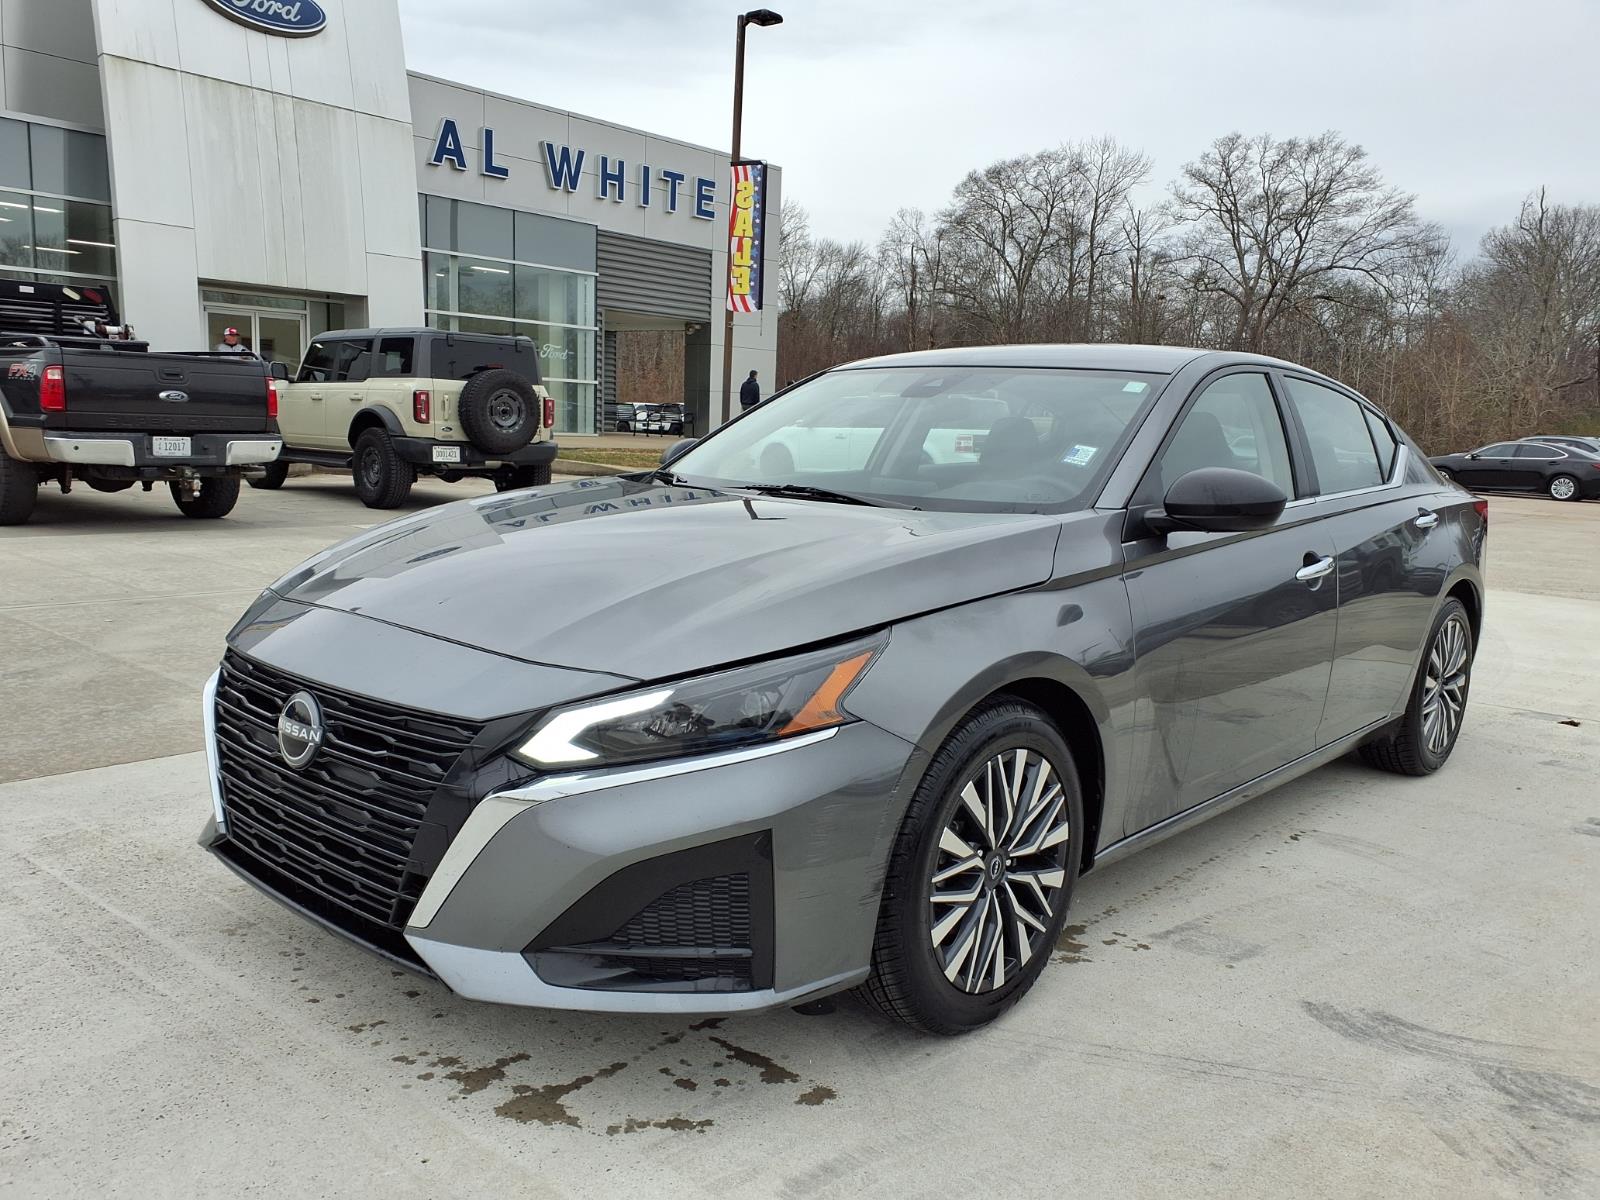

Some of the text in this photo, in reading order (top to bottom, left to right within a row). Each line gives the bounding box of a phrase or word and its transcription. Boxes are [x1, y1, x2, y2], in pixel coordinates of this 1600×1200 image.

[232, 0, 301, 21] ord
[429, 117, 716, 220] AL WHITE
[540, 343, 568, 360] Ford
[8, 363, 37, 378] FX4
[164, 441, 187, 452] 12017
